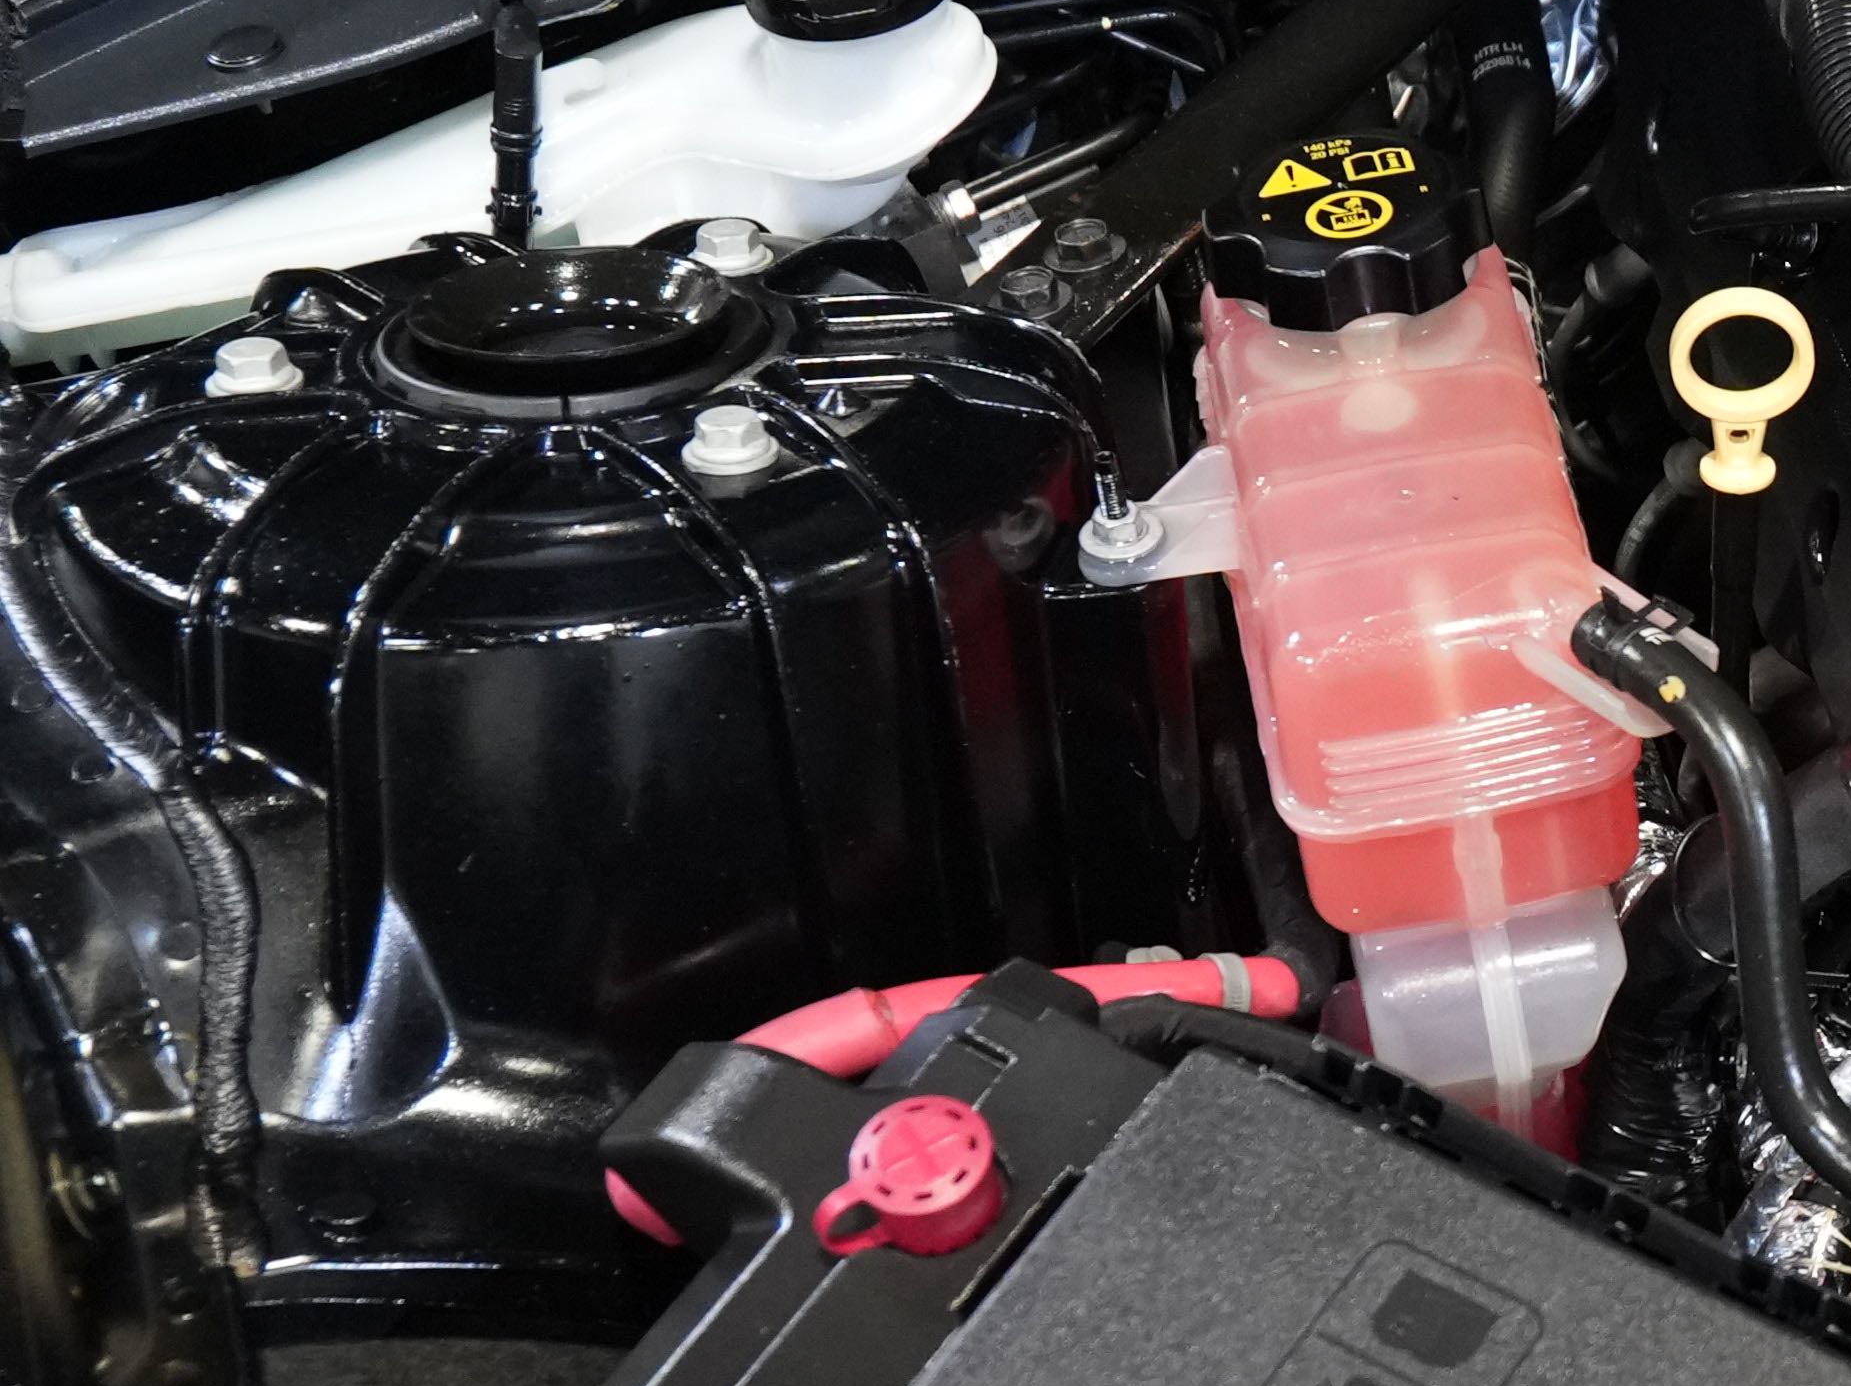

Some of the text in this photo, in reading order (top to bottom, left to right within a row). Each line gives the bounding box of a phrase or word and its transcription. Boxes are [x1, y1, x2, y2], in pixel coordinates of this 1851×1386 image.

[1303, 139, 1353, 154] 140 kPa
[1310, 146, 1350, 160] 20 PSI
